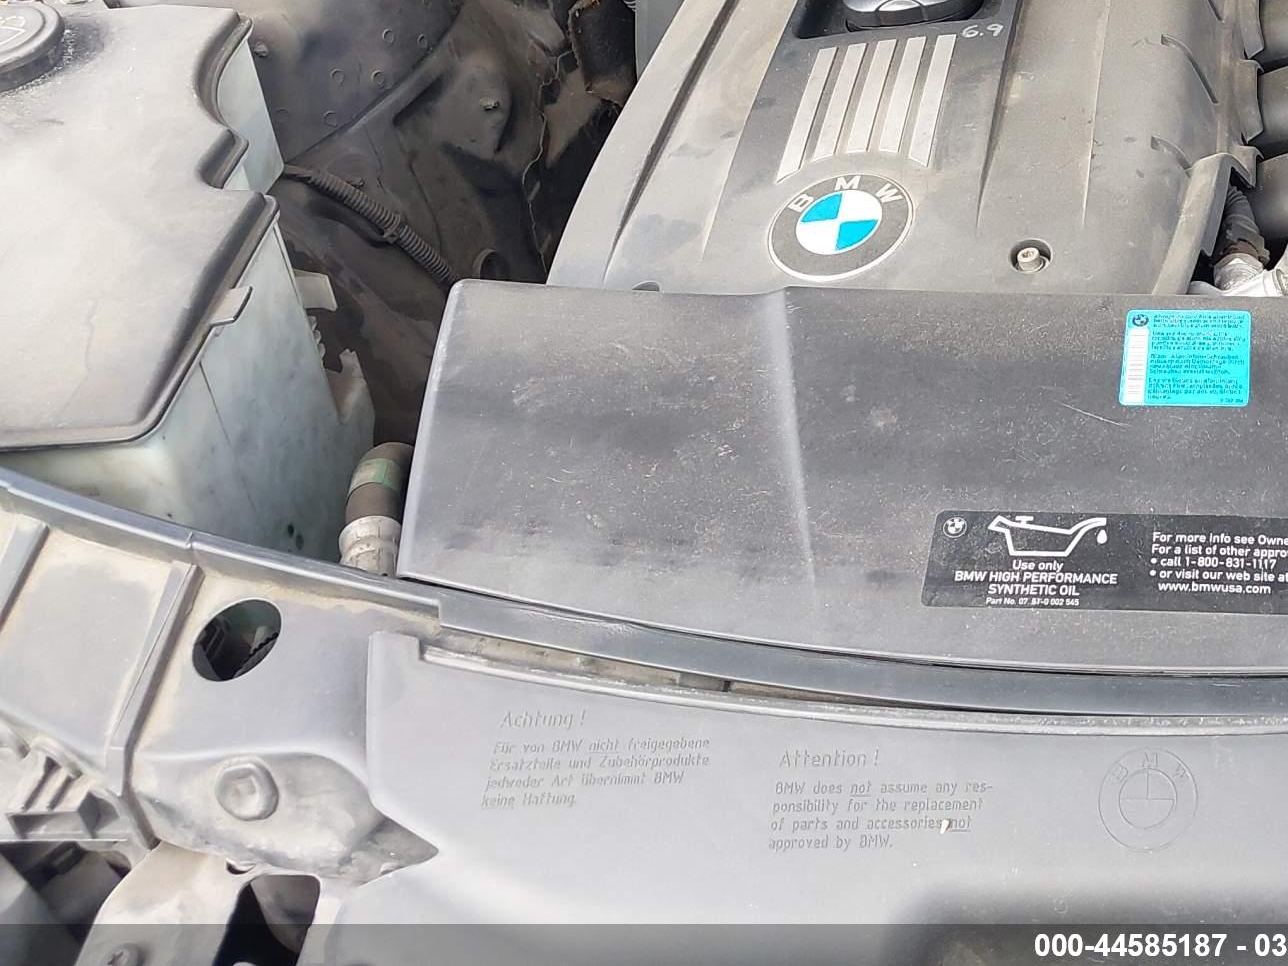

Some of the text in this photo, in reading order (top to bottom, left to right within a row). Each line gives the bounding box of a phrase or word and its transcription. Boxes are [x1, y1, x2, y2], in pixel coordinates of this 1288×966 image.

[788, 175, 905, 212] BMW
[1153, 532, 1172, 543] For
[1176, 535, 1206, 543] more
[1210, 533, 1230, 544] info
[1234, 536, 1254, 544] see
[1152, 544, 1171, 554] For
[1174, 547, 1181, 555] a
[1184, 545, 1202, 555] list
[1206, 545, 1217, 555] of
[1220, 546, 1250, 556] other
[1012, 560, 1063, 573] Use only
[1160, 557, 1276, 570] call 1-800-831-1117
[955, 571, 1117, 584] BMW HIGH PERFORMANCE
[1159, 569, 1288, 582] or visit our web site at
[988, 584, 1080, 596] SYNTHETIC OIL
[1158, 582, 1271, 594] www.bmwusa.com
[986, 597, 1001, 605] Part
[1004, 597, 1016, 605] No.
[500, 711, 574, 729] Achtung
[523, 743, 544, 753] von
[552, 740, 583, 753] BMW
[588, 738, 620, 754] nicht
[628, 737, 710, 752] freigegebene
[568, 757, 592, 769] und
[780, 750, 867, 767] Attention
[653, 770, 685, 784] BMW
[775, 780, 993, 796] BMW does not assume any res-
[772, 798, 983, 815] ponsibility for the replacement
[770, 815, 972, 834] of parts and accessories not
[768, 836, 828, 853] approved
[836, 836, 851, 852] by
